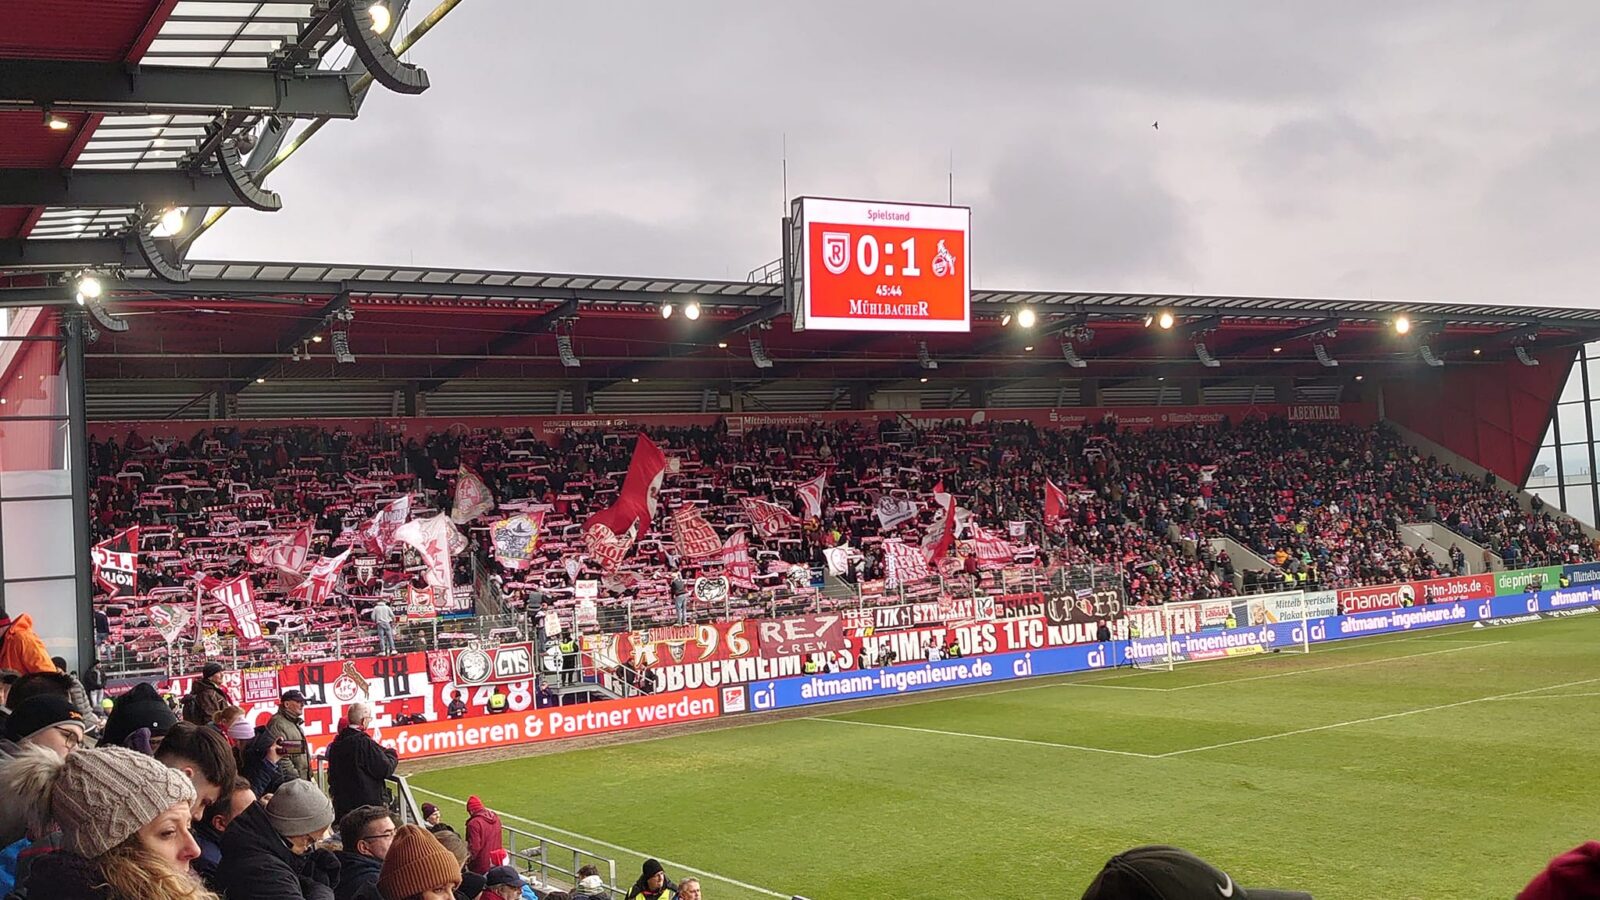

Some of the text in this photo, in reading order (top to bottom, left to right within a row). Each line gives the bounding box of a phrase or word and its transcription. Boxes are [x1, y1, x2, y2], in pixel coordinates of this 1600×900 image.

[867, 209, 910, 222] Spielstand
[856, 234, 920, 277] 0:1
[875, 284, 903, 297] 45:44
[849, 299, 929, 316] MÜHLBACHER
[1287, 405, 1340, 420] LABERTALER
[1512, 572, 1549, 590] printn
[1275, 594, 1335, 609] Mittelbyerische
[1343, 591, 1399, 612] charivari
[876, 607, 899, 627] LTK
[1341, 603, 1466, 634] altmann-ingenieure.de
[777, 641, 828, 655] CREW
[862, 628, 946, 664] HEIMAT
[956, 624, 997, 655] DES
[1003, 619, 1044, 650] 1.FC
[1125, 626, 1275, 659] altmann-ingenieure.de
[801, 658, 993, 699] altmann-ingenieure.de
[374, 696, 714, 755] nformieren & Partner werden
